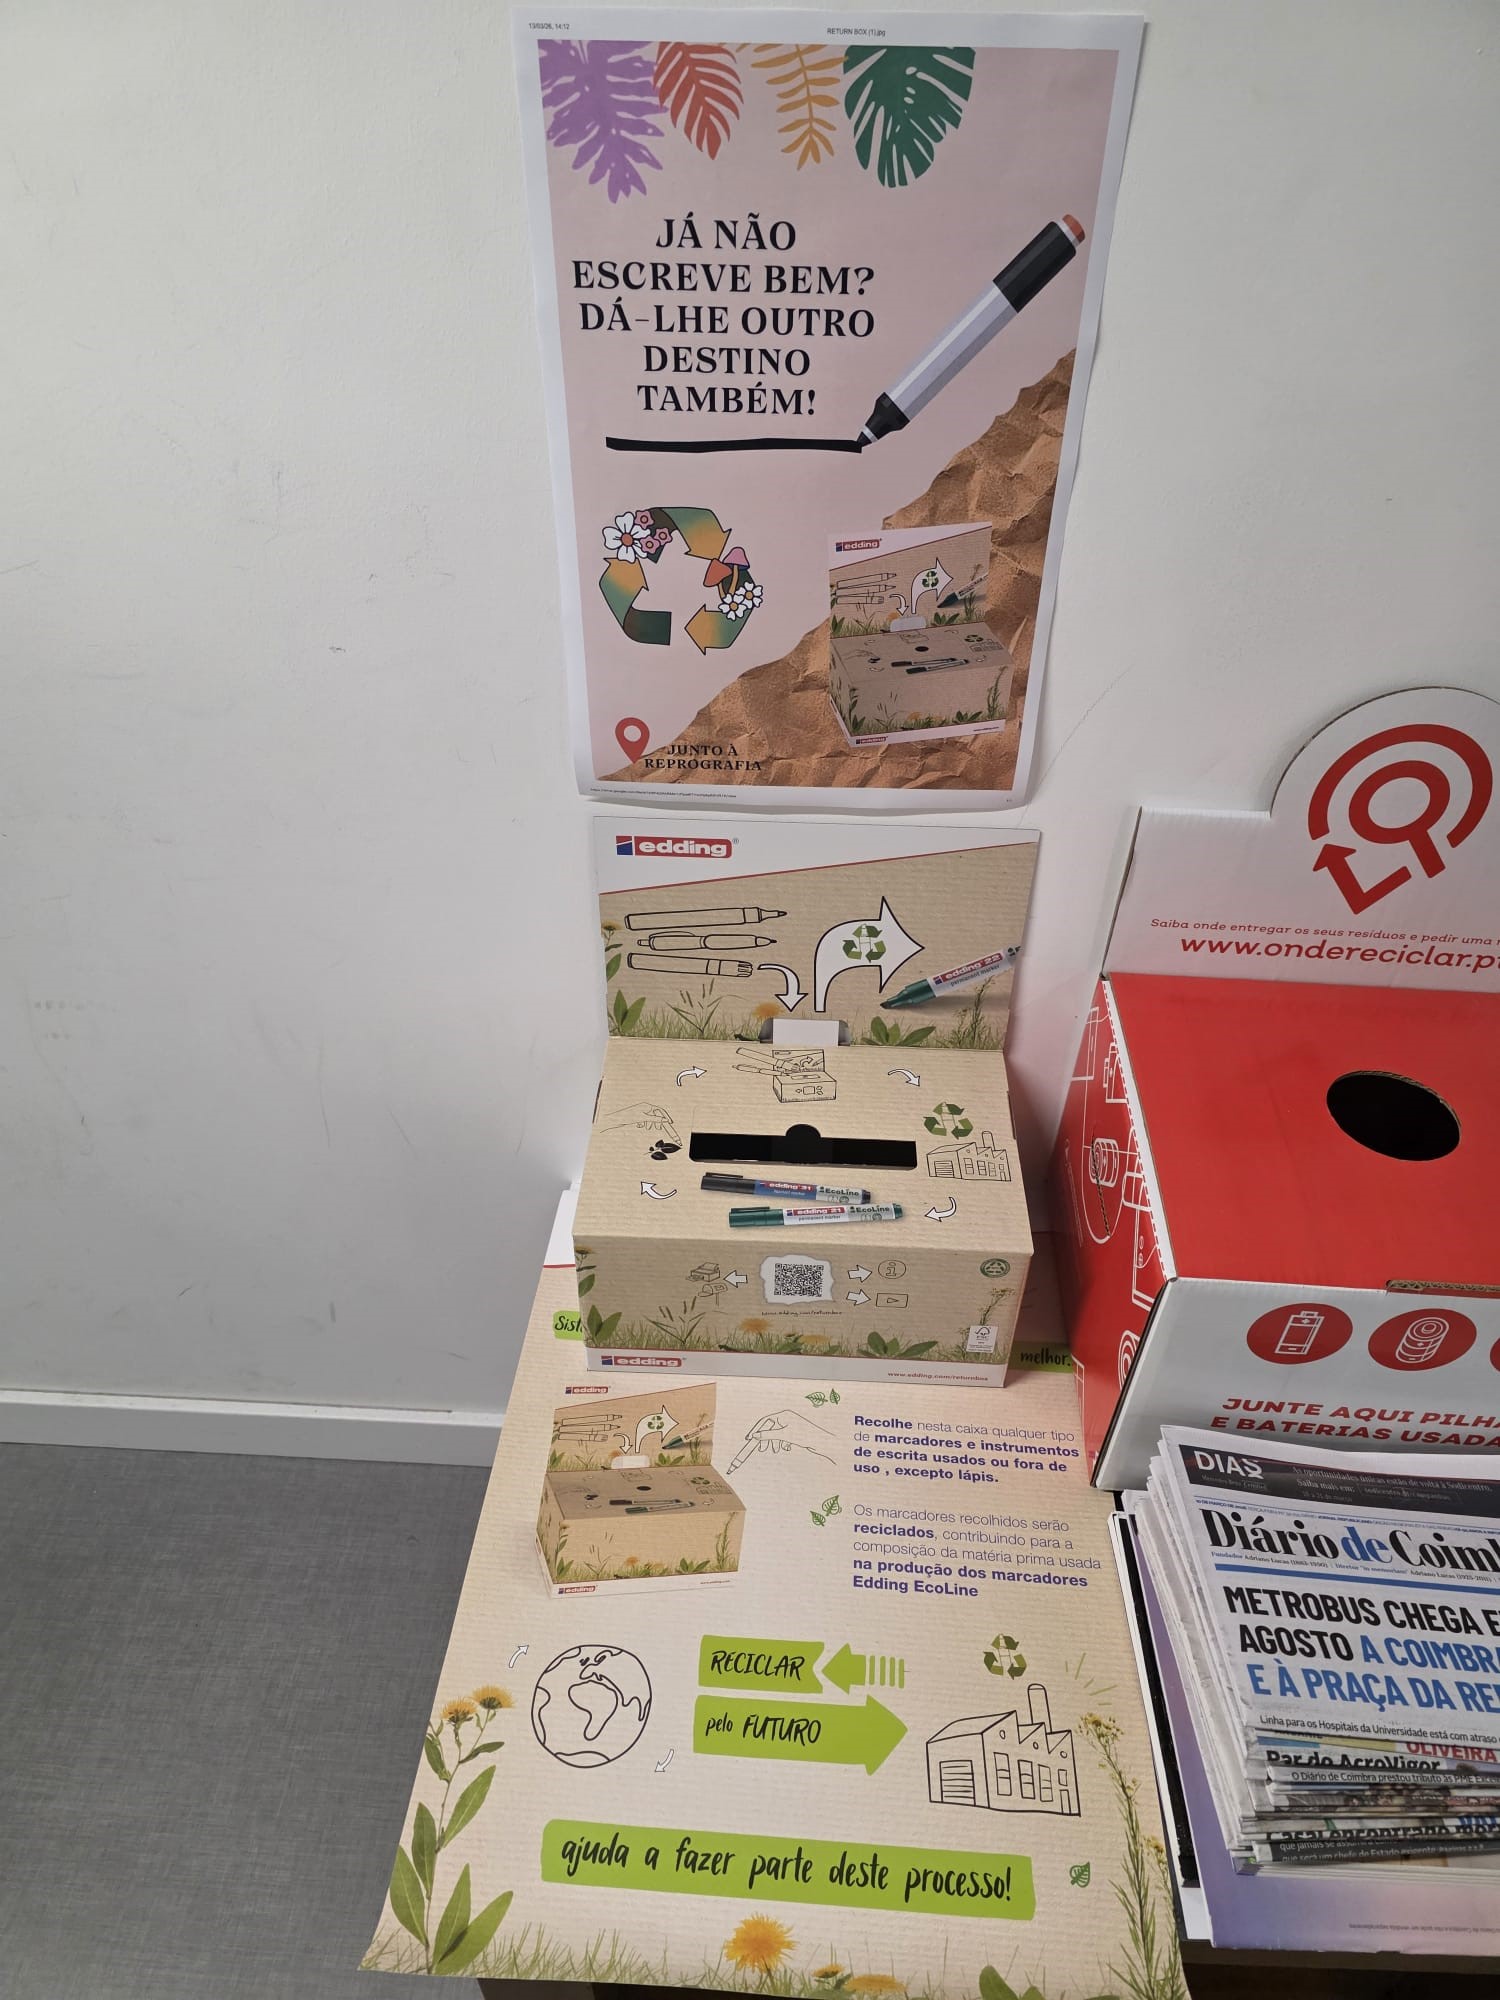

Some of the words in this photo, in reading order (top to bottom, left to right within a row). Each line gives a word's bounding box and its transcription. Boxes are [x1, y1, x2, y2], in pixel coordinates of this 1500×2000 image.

[826, 27, 852, 35] RETURN
[853, 28, 867, 36] BOX
[656, 211, 702, 250] JÁ
[715, 211, 797, 251] NÃO
[572, 260, 751, 293] ESCREVE
[764, 263, 874, 296] BEM?
[580, 296, 729, 334] DÁ-LHE
[741, 307, 875, 338] OUTRO
[644, 345, 810, 376] DESTINO
[637, 380, 816, 416] TAMBÉM!
[845, 541, 878, 550] edding
[667, 744, 723, 756] JUNTO
[728, 744, 738, 756] À
[645, 758, 762, 771] REPROGRAFIA
[1151, 919, 1189, 929] Saiba
[1193, 921, 1226, 931] onde
[1230, 924, 1291, 935] entregar
[1295, 926, 1309, 935] os
[1313, 928, 1344, 937] seus
[1348, 927, 1406, 941] resíduos
[1410, 933, 1418, 941] e
[1421, 934, 1458, 943] pedir
[1462, 937, 1492, 945] uma
[945, 962, 982, 980] edding
[984, 954, 1001, 965] 22
[769, 1182, 799, 1191] edding
[825, 1188, 859, 1197] EcoLine
[797, 1208, 827, 1216] edding
[855, 1205, 890, 1213] EcoLine
[617, 1358, 679, 1367] edding
[1021, 1348, 1071, 1367] melhor.
[888, 1372, 989, 1382] www.edding.com/returnbox
[1222, 1398, 1323, 1416] JUNTE
[1329, 1406, 1414, 1423] AQUI
[854, 1416, 912, 1429] Recolhe
[917, 1421, 952, 1433] nesta
[956, 1423, 988, 1435] caixa
[992, 1426, 1047, 1442] qualquer
[1051, 1430, 1075, 1444] tipo
[1211, 1416, 1229, 1428] E
[1236, 1418, 1393, 1440] BATERIAS
[854, 1431, 870, 1442] de
[874, 1433, 962, 1449] marcadores
[967, 1440, 976, 1449] e
[981, 1439, 1080, 1457] instrumentos
[854, 1447, 872, 1457] de
[877, 1448, 928, 1462] escrita
[933, 1452, 986, 1466] usados
[991, 1458, 1009, 1468] ou
[1014, 1457, 1044, 1471] fora
[1049, 1460, 1067, 1472] de
[854, 1463, 880, 1474] uso
[895, 1466, 953, 1480] excepto
[958, 1468, 999, 1484] lápis.
[854, 1504, 873, 1517] Os
[877, 1506, 956, 1524] marcadores
[960, 1512, 1028, 1529] recolhidos
[1032, 1518, 1070, 1532] serão
[854, 1523, 938, 1540] reciclados,
[942, 1528, 1026, 1546] contribuindo
[1030, 1537, 1060, 1550] para
[1064, 1541, 1074, 1550] a
[1199, 1507, 1339, 1559] Diário
[1341, 1526, 1393, 1563] de
[854, 1541, 936, 1558] composição
[940, 1546, 958, 1559] da
[962, 1549, 1012, 1563] matéria
[1016, 1553, 1055, 1567] prima
[1059, 1556, 1101, 1569] usada
[854, 1558, 872, 1570] na
[877, 1559, 953, 1578] produção
[958, 1566, 987, 1579] dos
[992, 1569, 1089, 1587] marcadores
[853, 1576, 908, 1594] Edding
[914, 1578, 978, 1597] EcoLine
[1223, 1586, 1381, 1626] METROBUS
[1383, 1600, 1483, 1636] CHEGA
[1482, 1608, 1500, 1637] E
[1239, 1624, 1354, 1661] AGOSTO
[1360, 1635, 1384, 1664] A
[710, 1650, 805, 1681] RECICLAR
[1247, 1663, 1271, 1696] E
[1273, 1658, 1301, 1698] À
[1301, 1668, 1408, 1712] PRAÇA
[1407, 1677, 1461, 1711] DA
[706, 1716, 733, 1738] pelo
[742, 1715, 822, 1746] FUTURO
[1260, 1715, 1284, 1726] Linha
[1286, 1718, 1306, 1729] para
[1307, 1720, 1317, 1729] os
[1319, 1720, 1359, 1732] Hospitais
[1360, 1723, 1371, 1733] da
[1372, 1725, 1428, 1738] Universidade
[1430, 1730, 1448, 1740] está
[1450, 1733, 1467, 1742] com
[1470, 1734, 1498, 1744] atraso
[1406, 1741, 1498, 1762] OLIVEIRA
[1292, 1772, 1299, 1780] O
[1301, 1771, 1326, 1780] Diário
[1328, 1772, 1339, 1781] de
[1340, 1772, 1377, 1782] Coimbra
[1378, 1774, 1412, 1784] prestou
[1412, 1773, 1441, 1782] tributo
[1280, 1843, 1296, 1851] que
[1296, 1842, 1324, 1852] jamais
[562, 1834, 629, 1877] ajuda
[645, 1845, 660, 1865] a
[676, 1836, 735, 1876] fazer
[749, 1848, 812, 1889] parte
[829, 1852, 888, 1890] deste
[905, 1866, 1011, 1903] processo!
